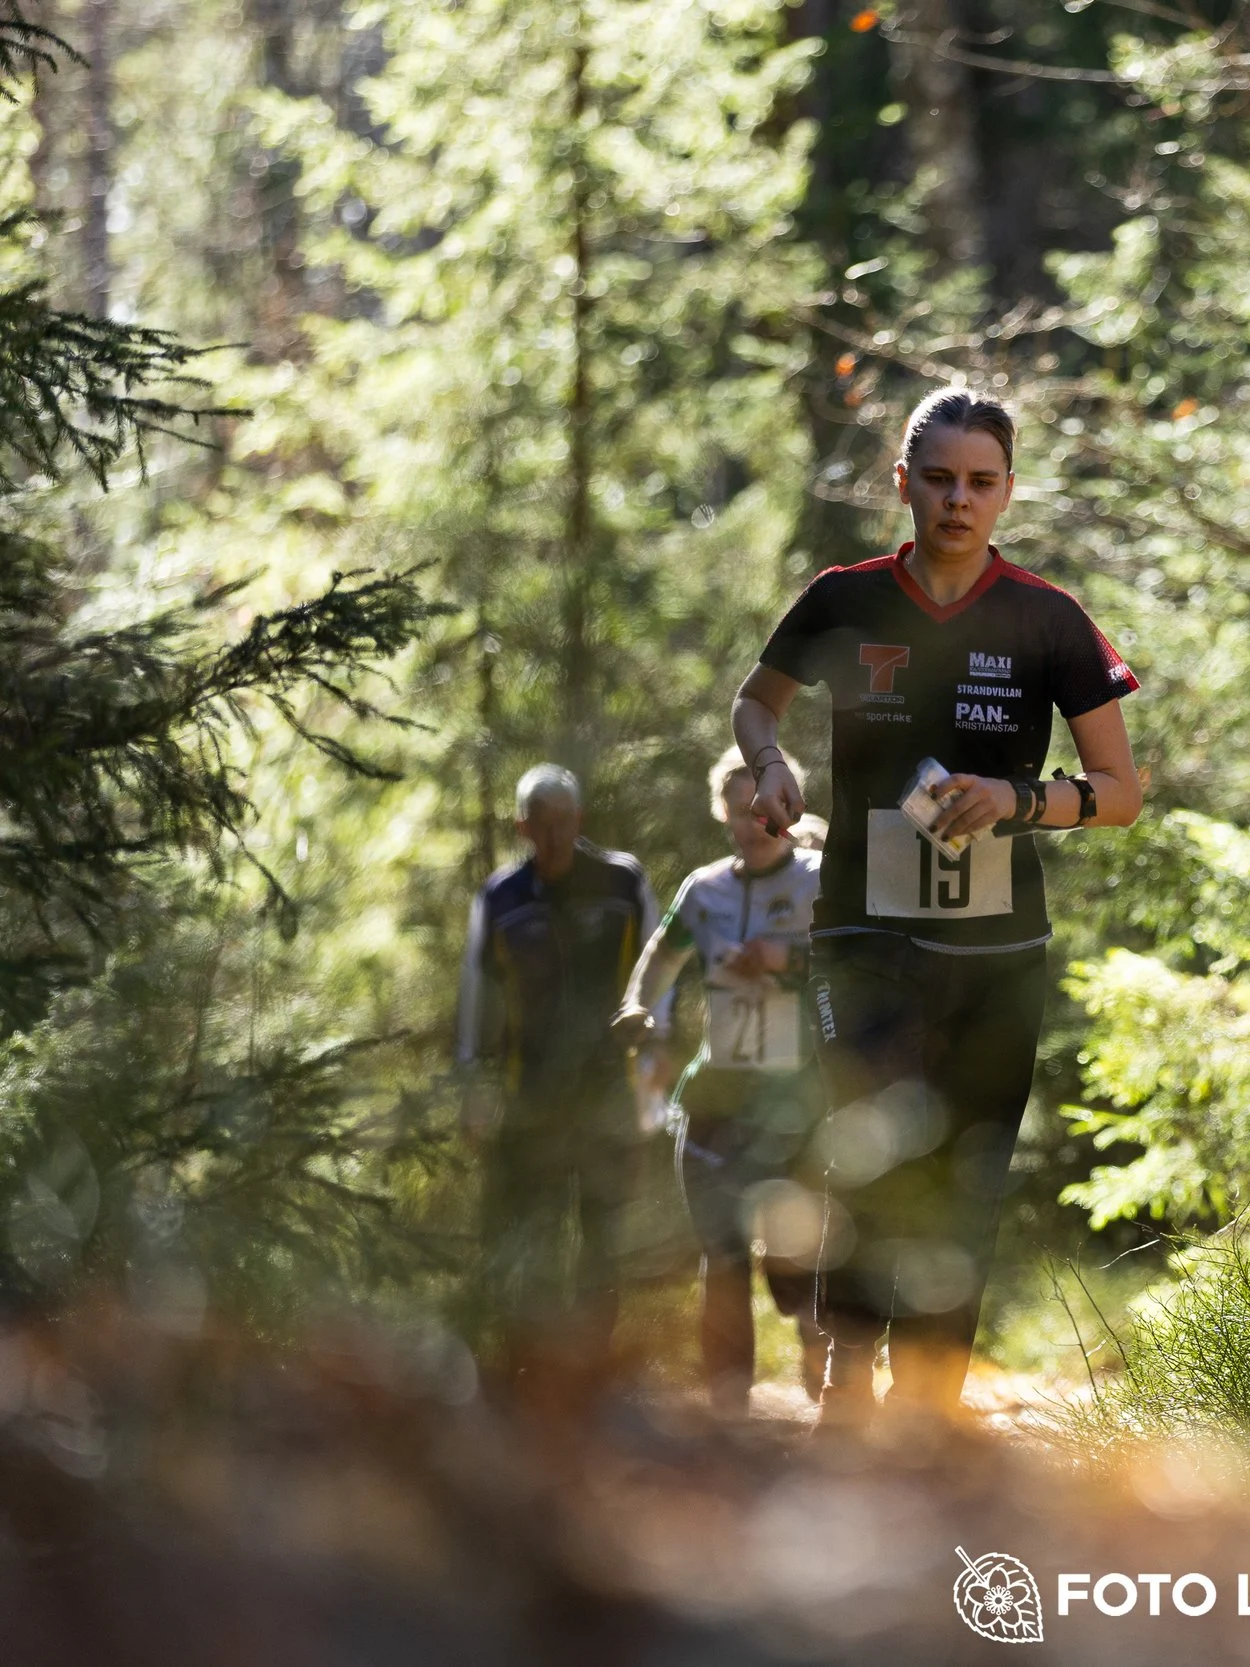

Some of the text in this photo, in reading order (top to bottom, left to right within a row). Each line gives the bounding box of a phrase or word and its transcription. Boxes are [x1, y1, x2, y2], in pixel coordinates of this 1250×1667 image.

[957, 684, 1022, 697] STRANDVILLAN
[955, 720, 1019, 733] KRISTIANSTAD
[956, 702, 1010, 723] PAN-
[916, 831, 971, 908] 19
[732, 996, 766, 1064] 21
[816, 981, 837, 1043] TRIMTEX
